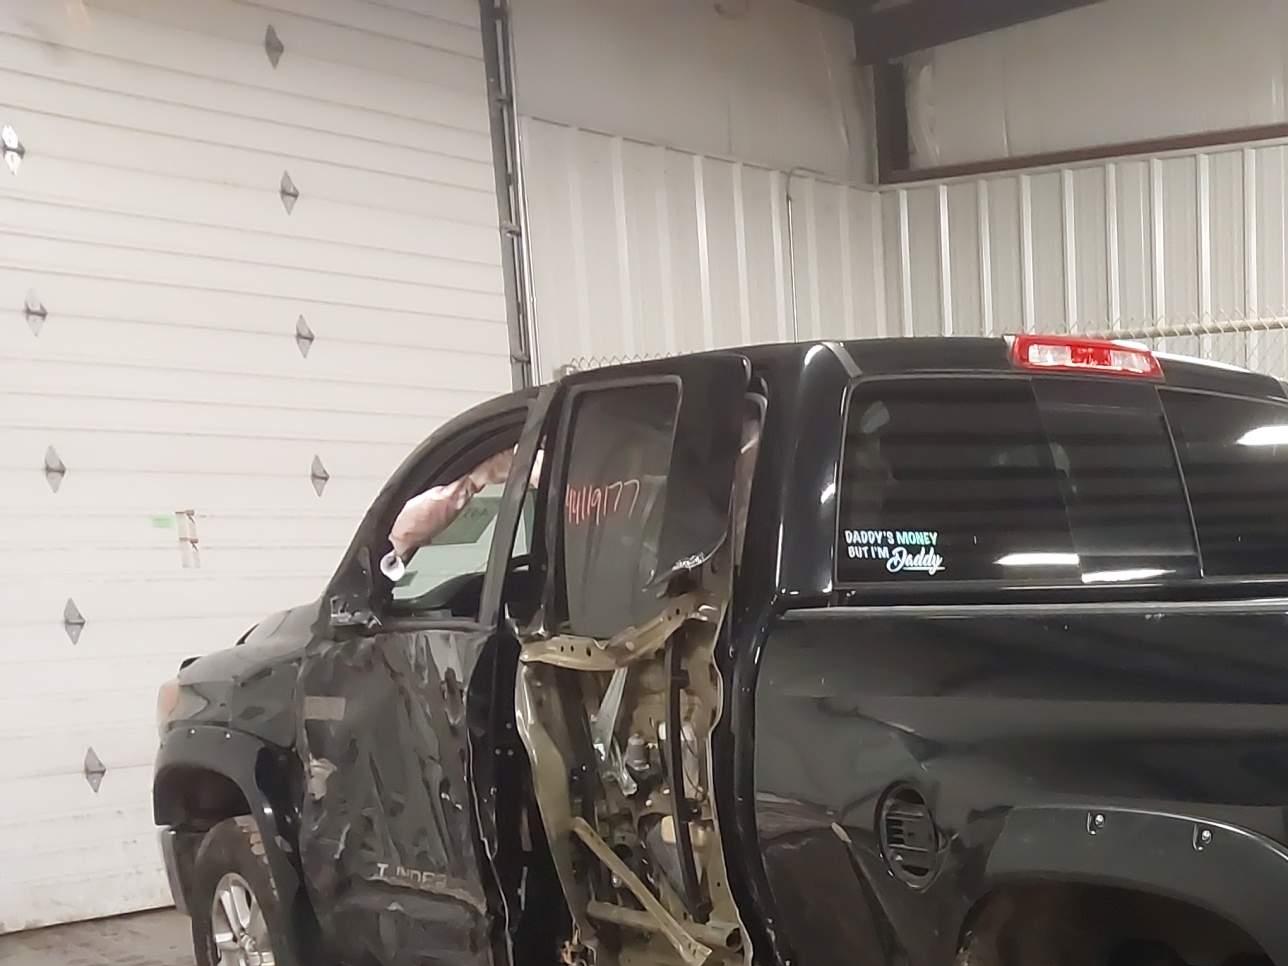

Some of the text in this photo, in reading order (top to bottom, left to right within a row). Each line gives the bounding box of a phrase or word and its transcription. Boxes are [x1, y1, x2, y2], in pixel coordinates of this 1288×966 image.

[565, 479, 640, 526] 44119177
[845, 530, 938, 546] DADDY'S MONEY
[848, 546, 945, 575] BUT I'M Daddy
